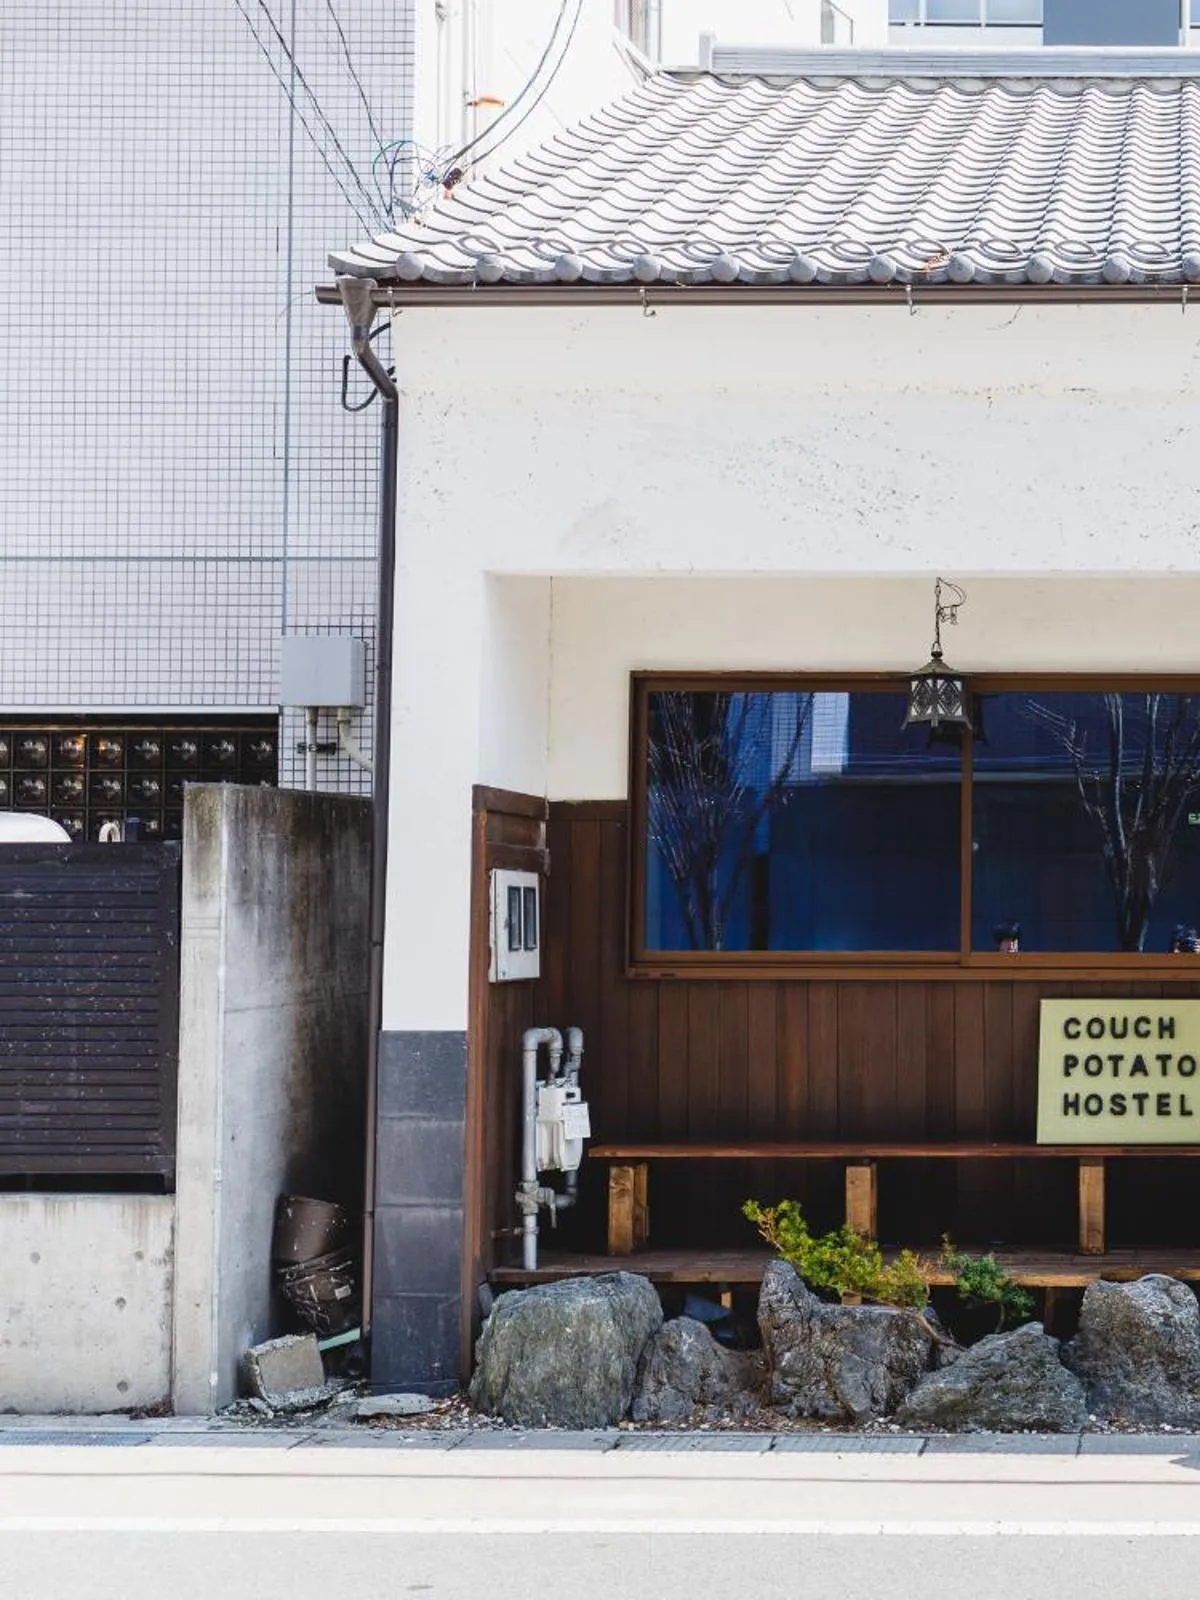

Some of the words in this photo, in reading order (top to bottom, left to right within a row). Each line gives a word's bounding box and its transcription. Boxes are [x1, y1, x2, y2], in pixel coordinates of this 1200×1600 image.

[1063, 1016, 1176, 1039] COUCH
[1063, 1054, 1197, 1077] POTATO
[1063, 1092, 1194, 1117] HOSTEL
